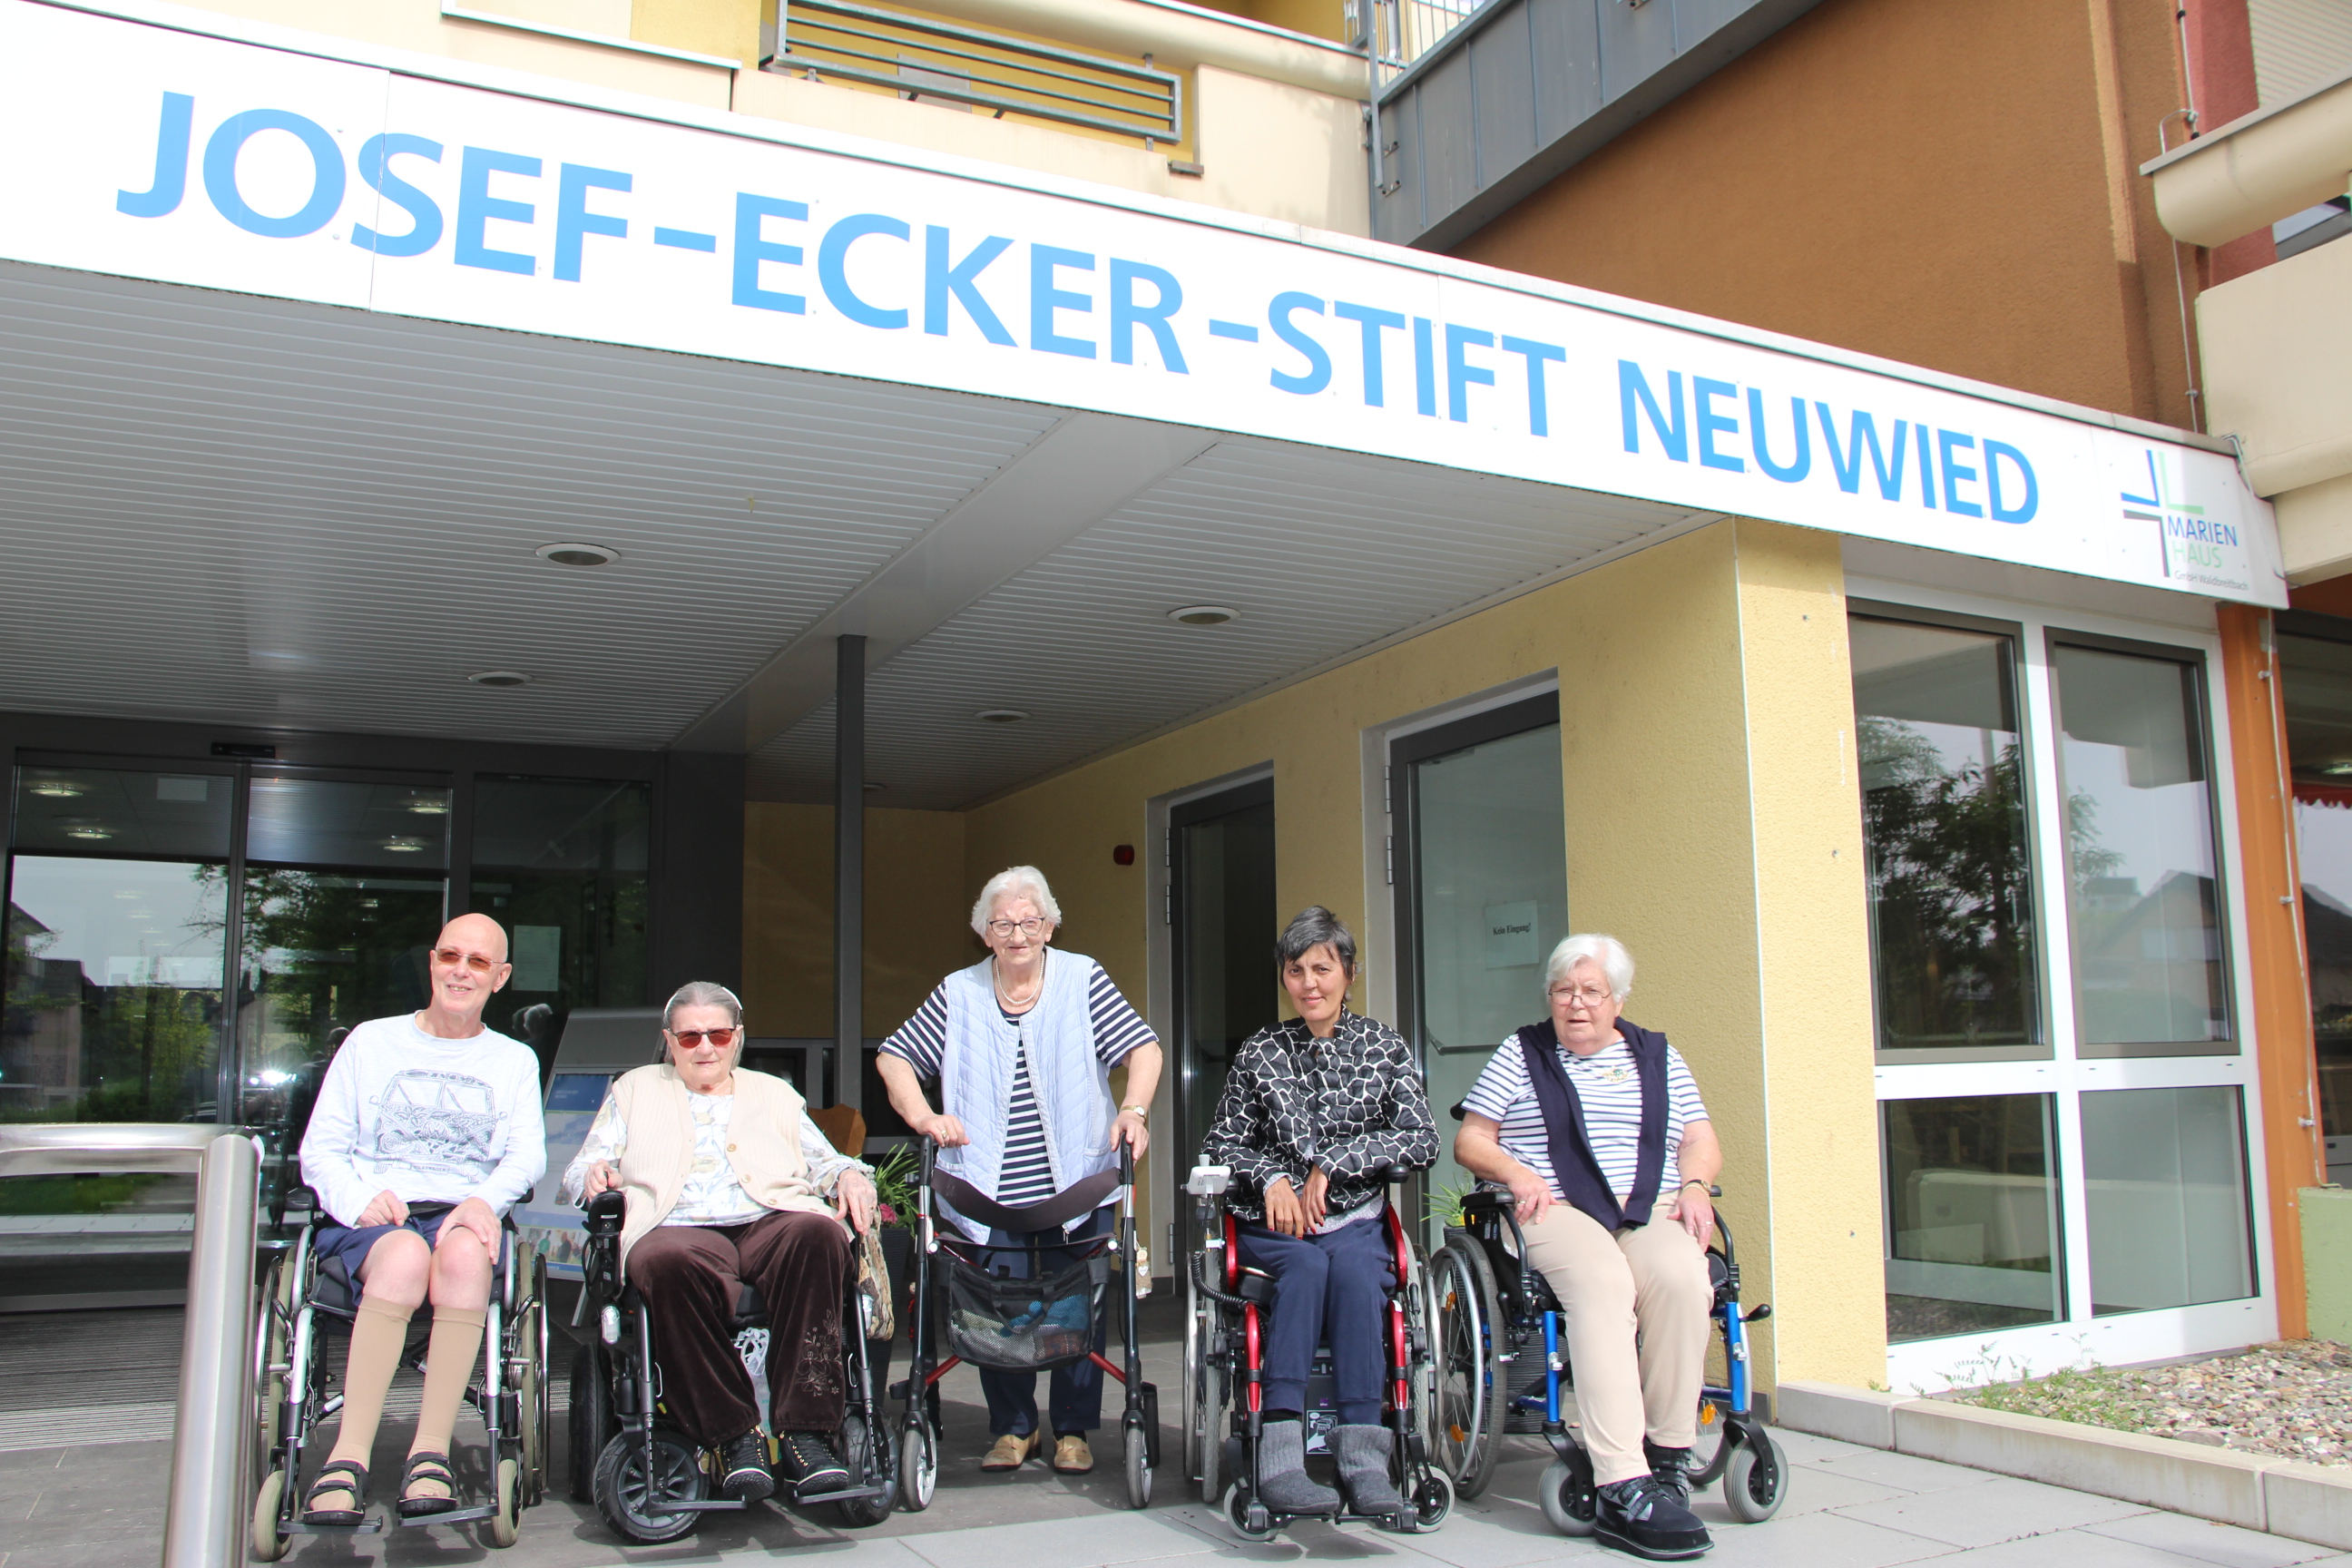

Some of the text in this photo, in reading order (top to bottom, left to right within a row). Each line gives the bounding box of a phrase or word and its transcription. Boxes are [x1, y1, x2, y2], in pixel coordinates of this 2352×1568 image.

[116, 91, 2039, 524] JOSEF-ECKER-STIFT NEUWIED
[2168, 514, 2238, 546] MARIEN
[2171, 540, 2222, 568] HAUS
[2174, 570, 2198, 583] GmbH
[1493, 923, 1531, 935] Kein Eingang!
